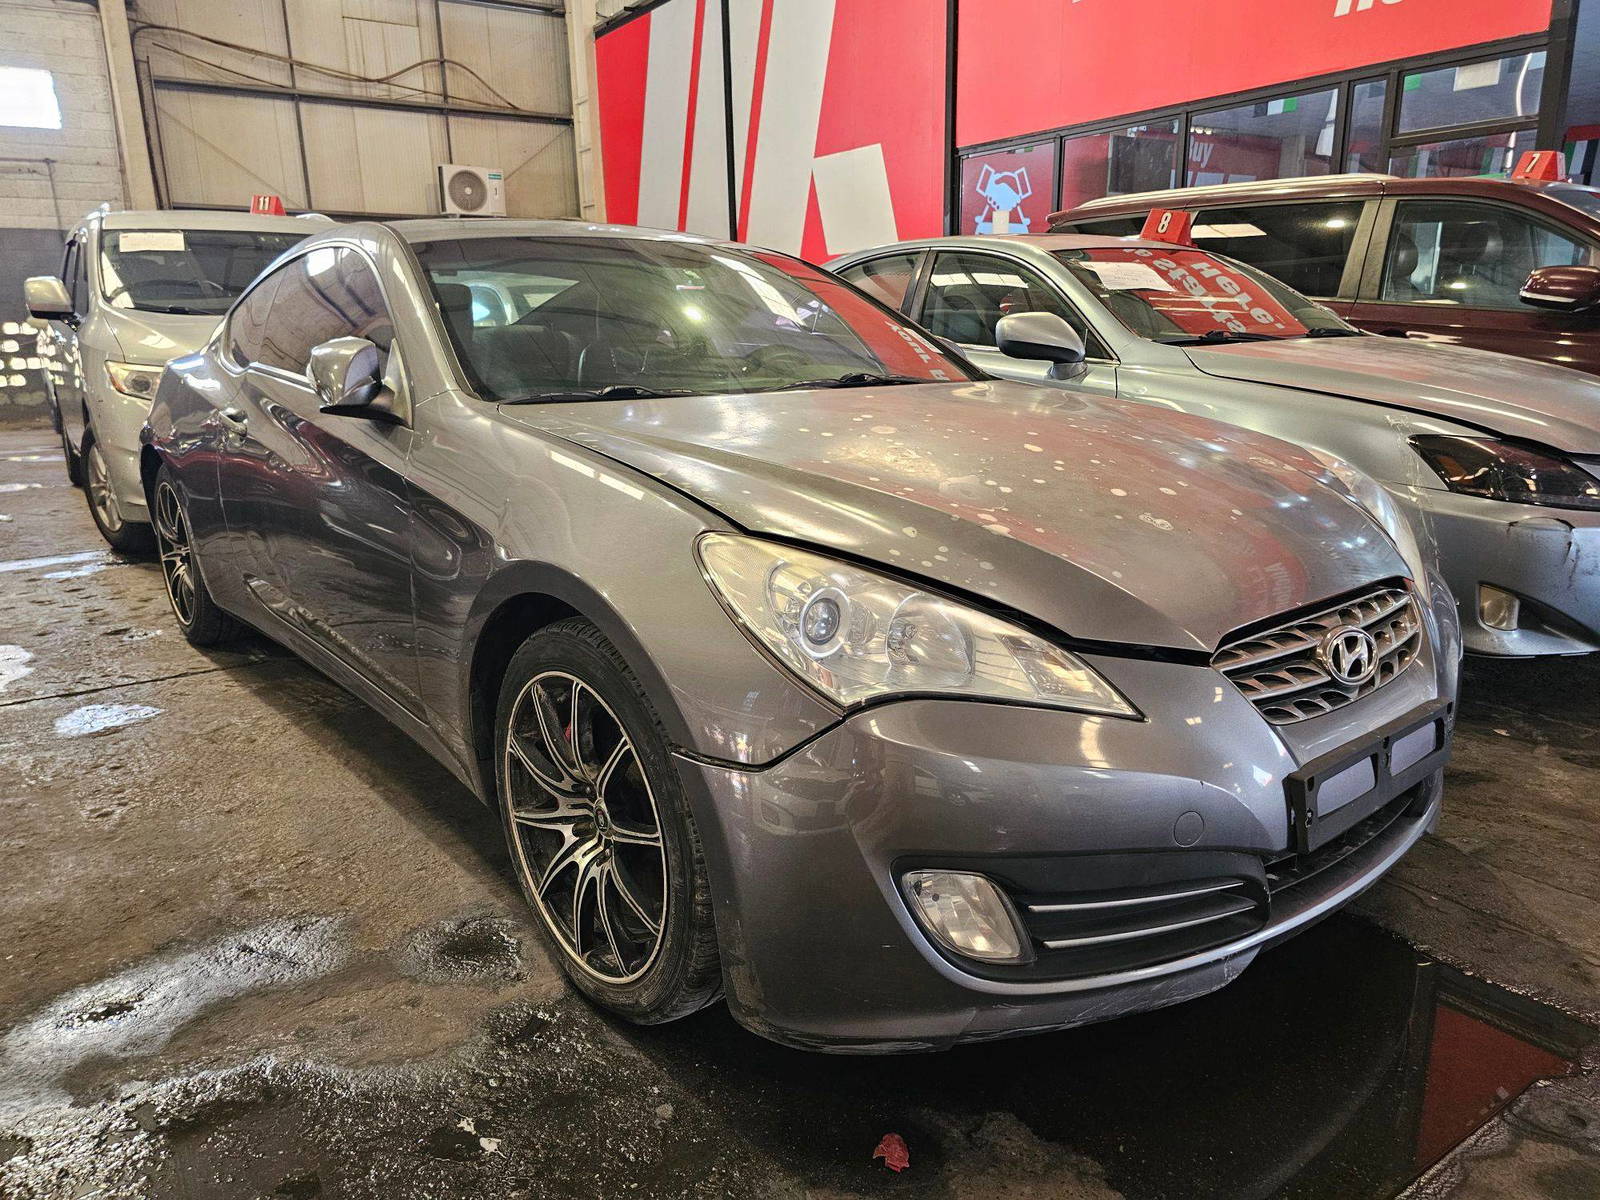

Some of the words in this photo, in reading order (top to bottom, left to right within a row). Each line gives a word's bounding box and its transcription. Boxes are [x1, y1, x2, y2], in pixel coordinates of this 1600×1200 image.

[1525, 153, 1541, 173] 7
[258, 196, 270, 211] 11
[1157, 212, 1171, 234] 8
